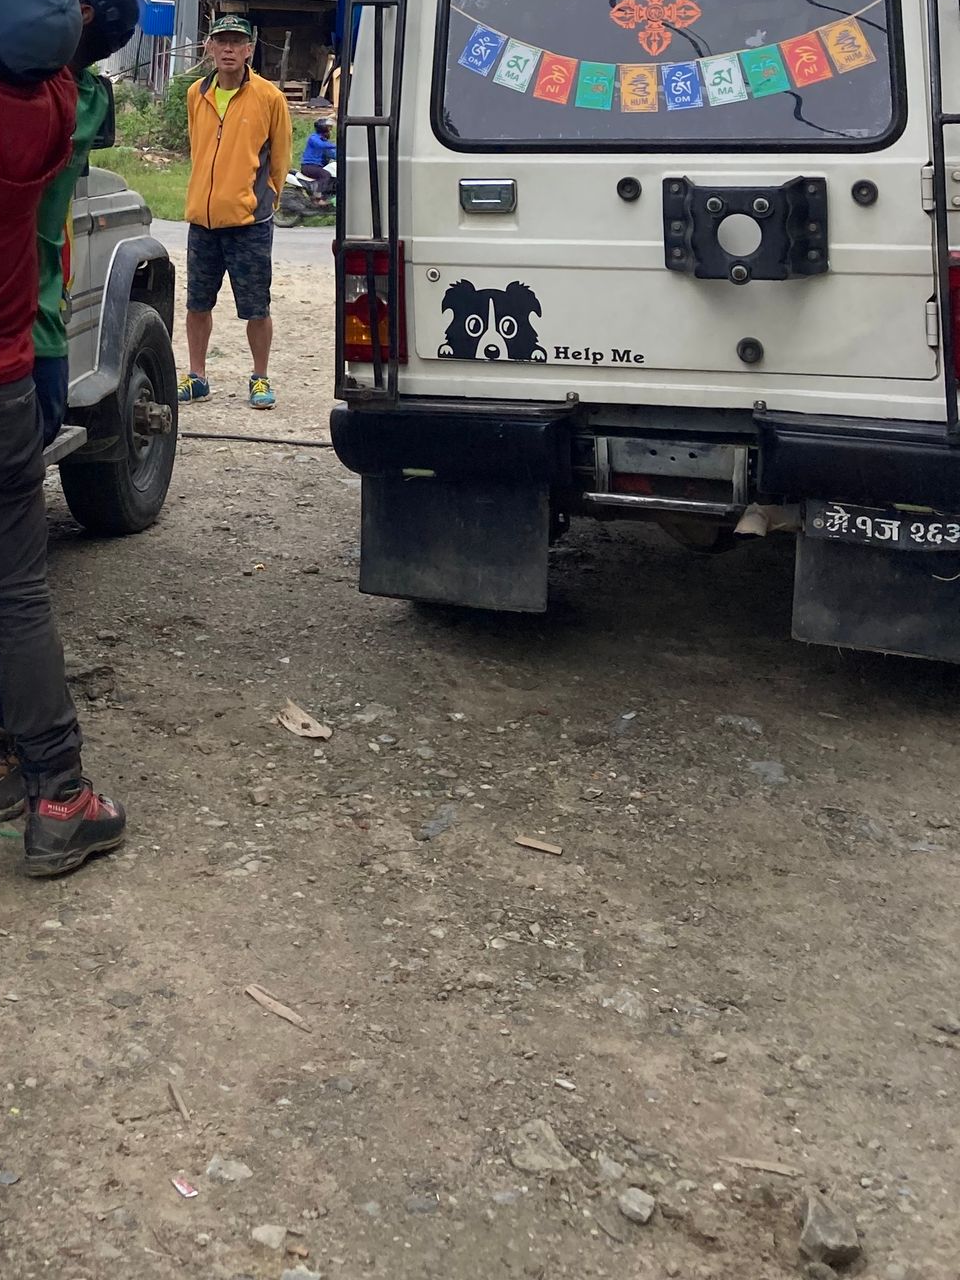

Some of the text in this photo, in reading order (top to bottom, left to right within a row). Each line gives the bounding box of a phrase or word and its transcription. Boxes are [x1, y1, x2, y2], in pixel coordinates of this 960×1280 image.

[468, 56, 482, 67] OM
[505, 71, 520, 81] MA
[546, 84, 560, 93] NI
[630, 98, 649, 106] HUM
[717, 87, 734, 96] MA
[804, 64, 818, 77] NI
[553, 346, 645, 364] Help Me
